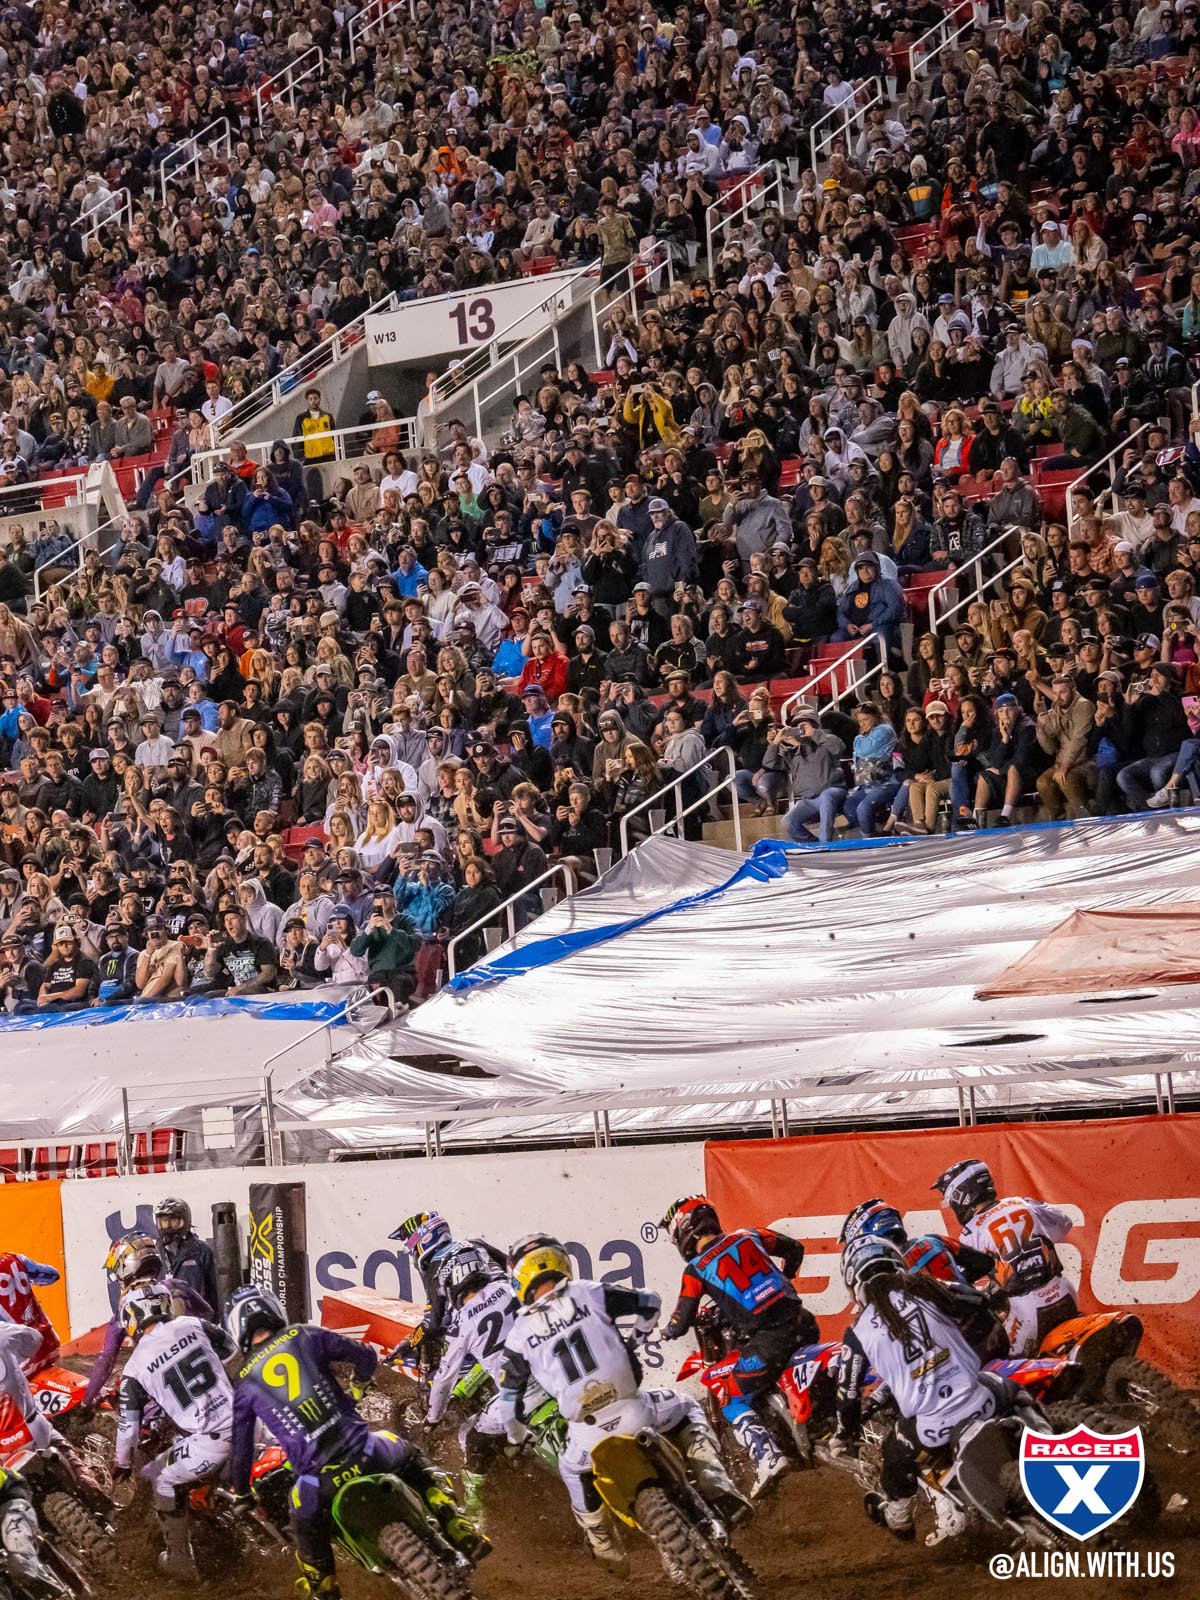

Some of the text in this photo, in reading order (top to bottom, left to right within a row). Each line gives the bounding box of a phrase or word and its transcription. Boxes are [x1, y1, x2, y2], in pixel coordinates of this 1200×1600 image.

[448, 298, 496, 345] 13
[541, 298, 566, 313] W4
[374, 331, 397, 344] W13
[276, 1206, 286, 1279] CHAMPIONSHIP
[987, 1208, 1043, 1264] 62
[262, 1257, 272, 1292] OSS
[717, 1237, 771, 1292] 14
[466, 1287, 507, 1321] ANDERSON
[147, 1331, 199, 1374] WILSON
[552, 1326, 599, 1385] 11
[46, 1379, 72, 1394] HONDA
[161, 1345, 219, 1411] 15
[261, 1352, 301, 1402] 9
[794, 1363, 808, 1390] 14
[38, 1390, 62, 1415] 96
[303, 1411, 342, 1444] Kawasaki
[331, 1464, 362, 1488] FOX
